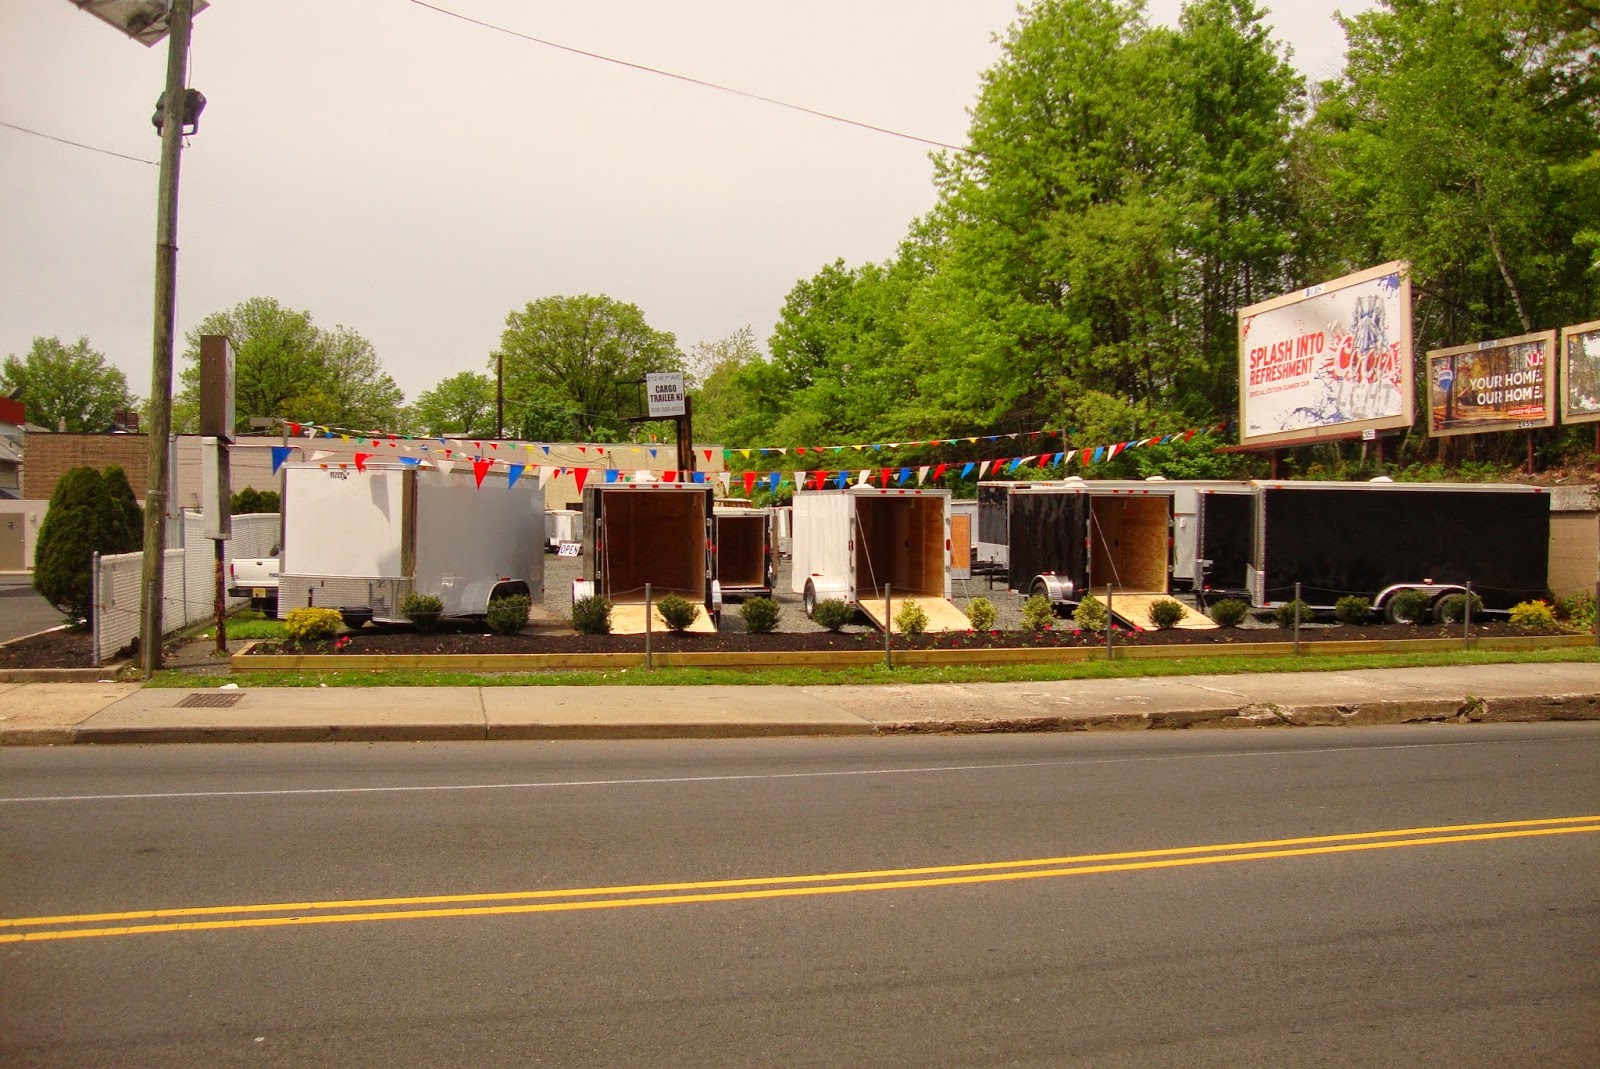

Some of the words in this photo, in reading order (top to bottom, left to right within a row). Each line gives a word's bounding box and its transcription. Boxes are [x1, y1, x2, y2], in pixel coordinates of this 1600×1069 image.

[1250, 339, 1293, 369] SPLASH
[1296, 331, 1324, 358] INTO
[1250, 357, 1314, 386] REFRESHMENT
[655, 385, 676, 393] CARGO
[1470, 375, 1502, 390] YOUR
[650, 394, 675, 402] TRAILER
[676, 393, 682, 401] NJ
[1477, 391, 1502, 405] OUR
[560, 545, 578, 554] OPEN
